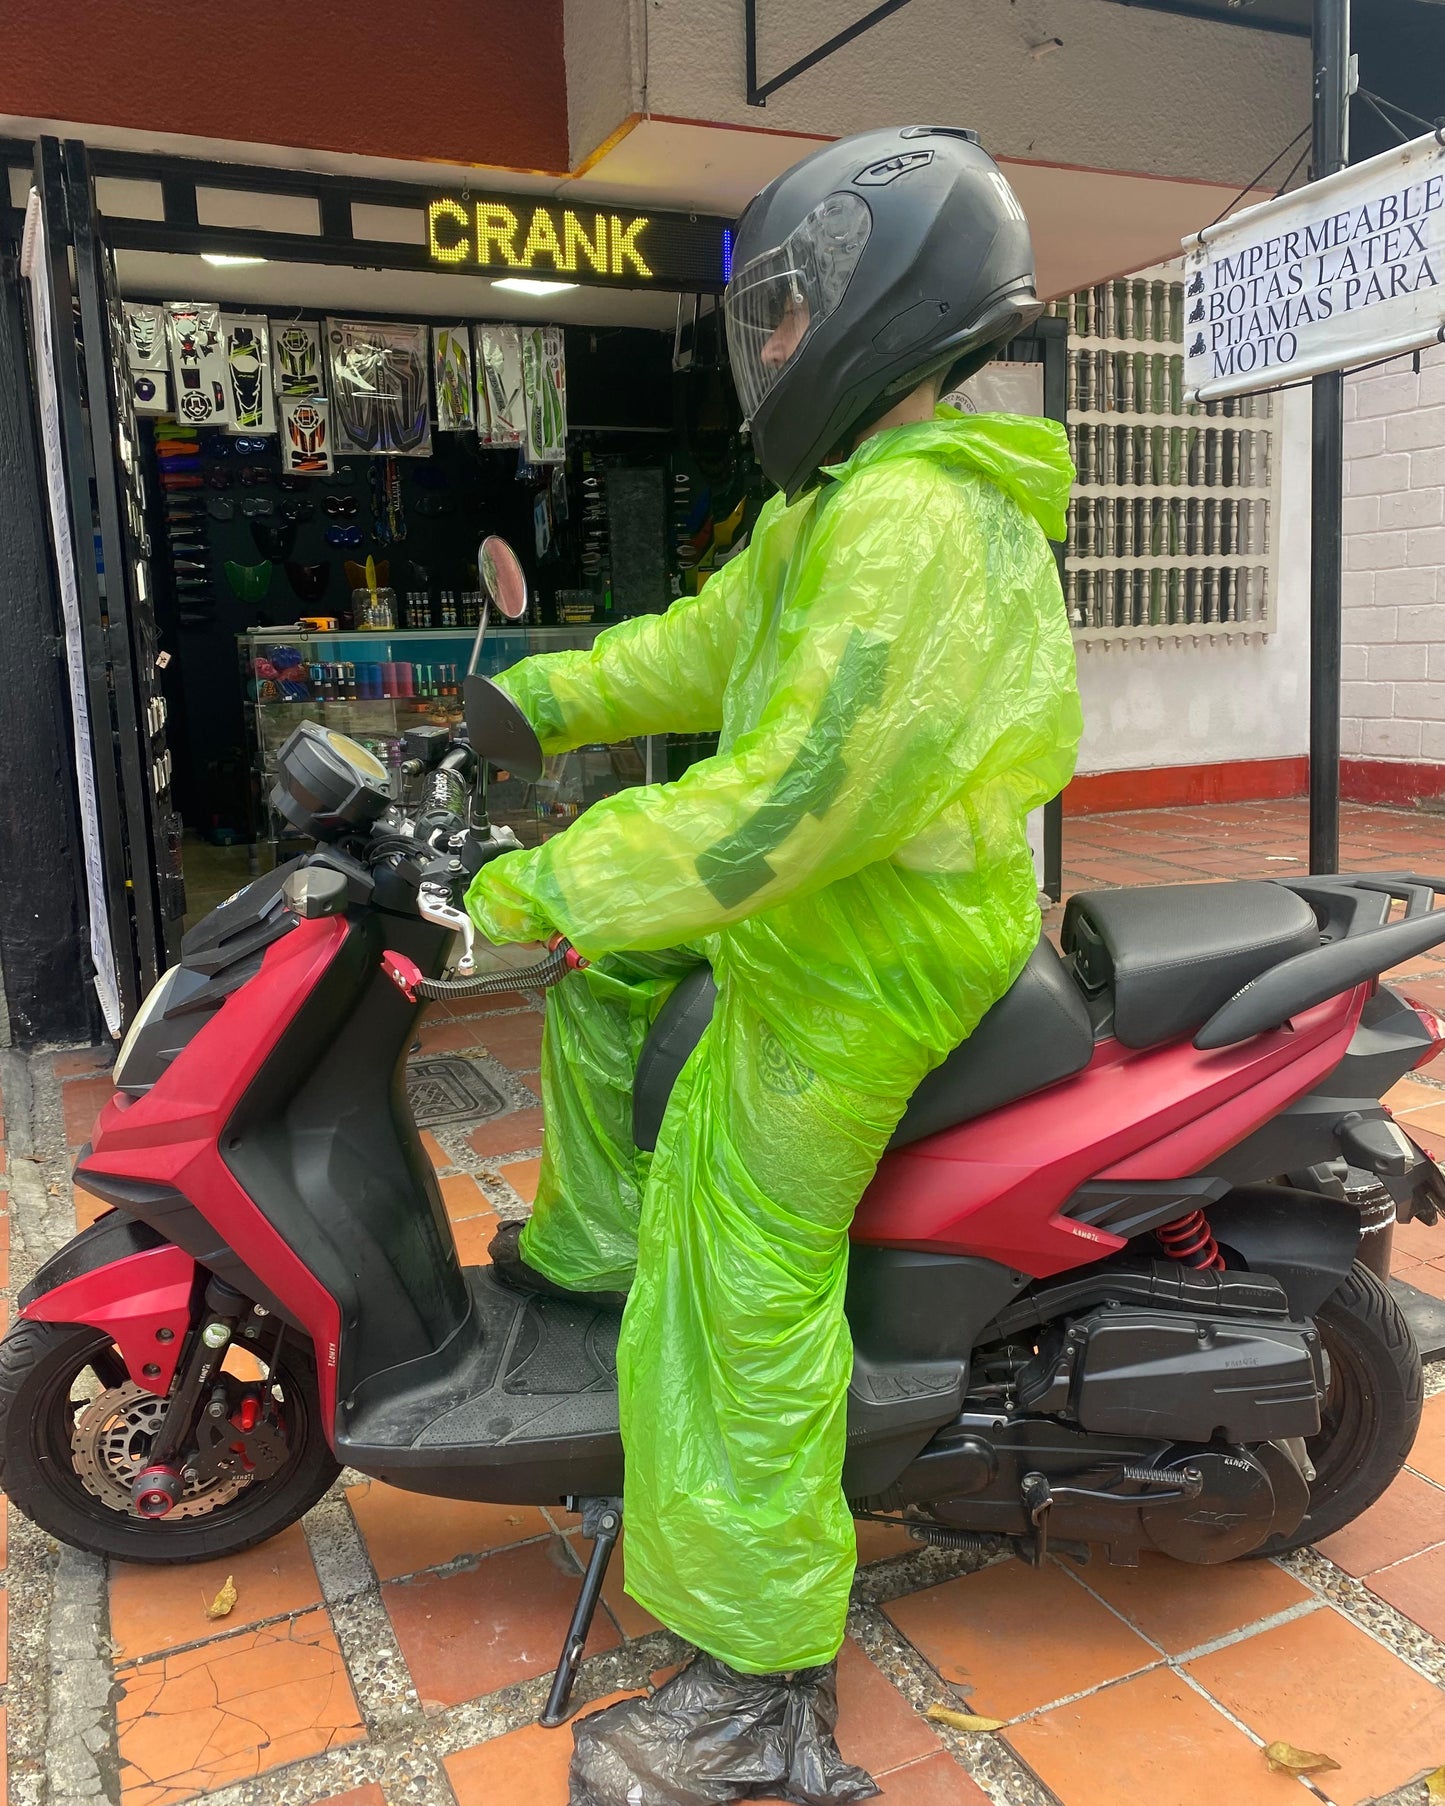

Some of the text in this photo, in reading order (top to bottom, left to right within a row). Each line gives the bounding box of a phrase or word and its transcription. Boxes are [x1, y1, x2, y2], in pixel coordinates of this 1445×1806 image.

[429, 198, 653, 276] CRANK
[1208, 217, 1430, 322] BOTAS LATEX
[1213, 174, 1444, 290] IMPERMEABLE
[1210, 255, 1439, 351] PIJAMAS PARA
[1213, 332, 1299, 379] MOTO
